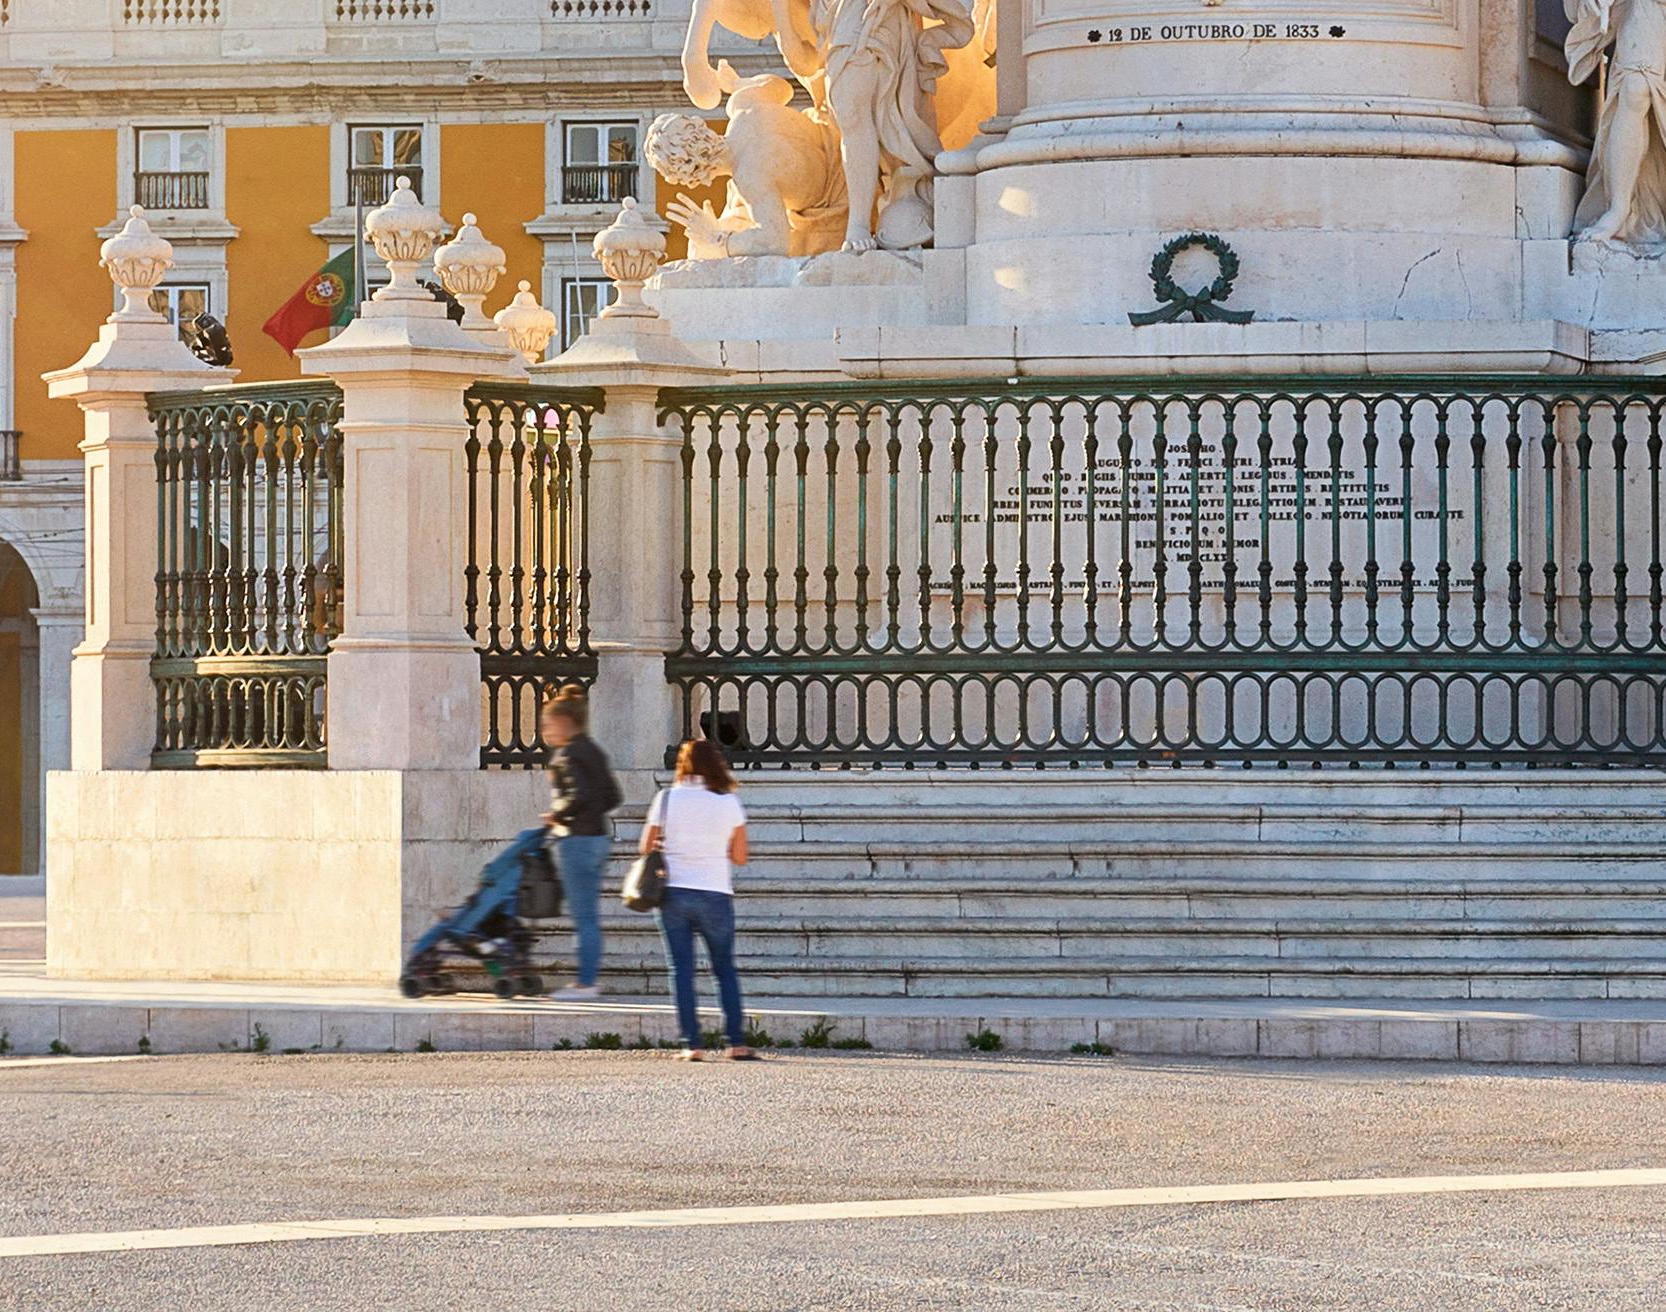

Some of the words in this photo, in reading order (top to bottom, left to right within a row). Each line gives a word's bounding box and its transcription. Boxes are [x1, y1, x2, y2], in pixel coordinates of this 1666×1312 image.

[1130, 27, 1152, 41] DE
[1160, 24, 1244, 40] OUTUBRO
[1253, 24, 1277, 38] DE
[1286, 24, 1319, 38] 1833
